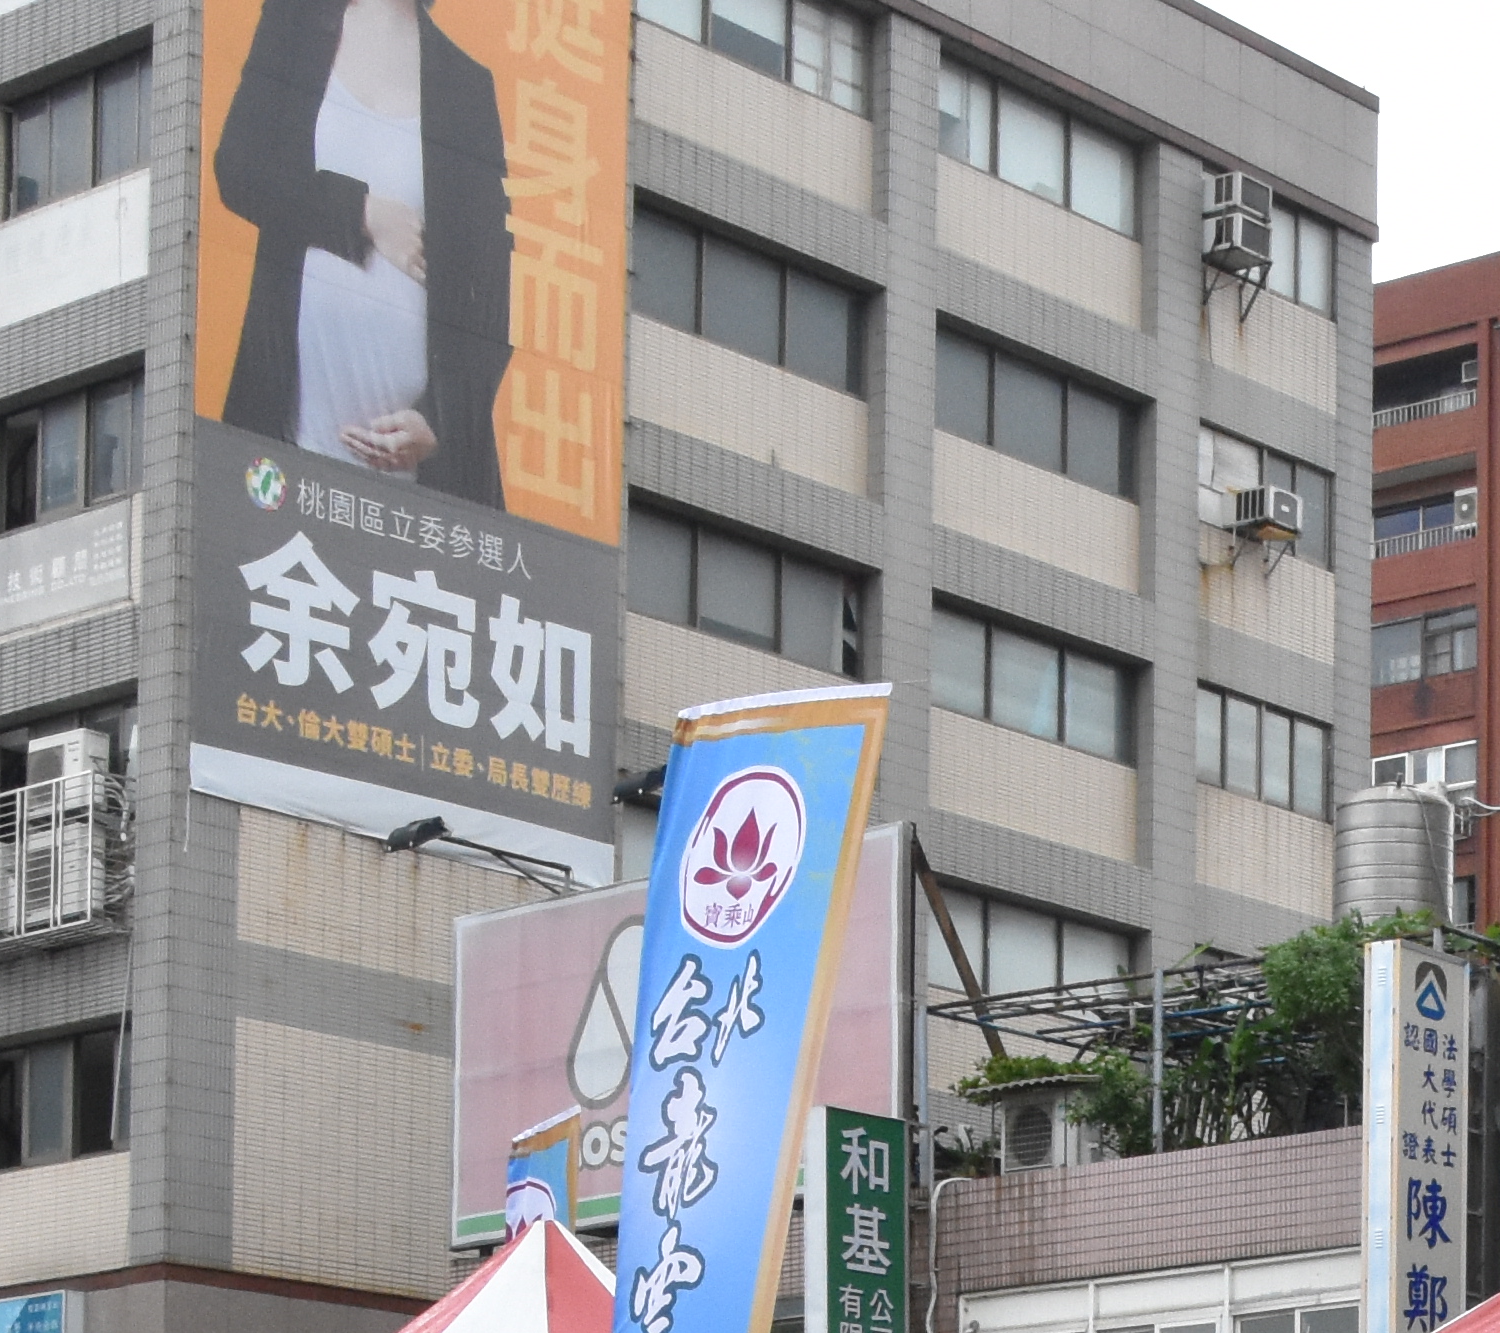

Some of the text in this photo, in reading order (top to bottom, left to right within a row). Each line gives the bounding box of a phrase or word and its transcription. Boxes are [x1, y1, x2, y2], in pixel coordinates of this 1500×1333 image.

[296, 479, 532, 580] 桃園區立委參選人
[238, 530, 592, 759] 余宛如
[841, 1127, 892, 1276] 和基
